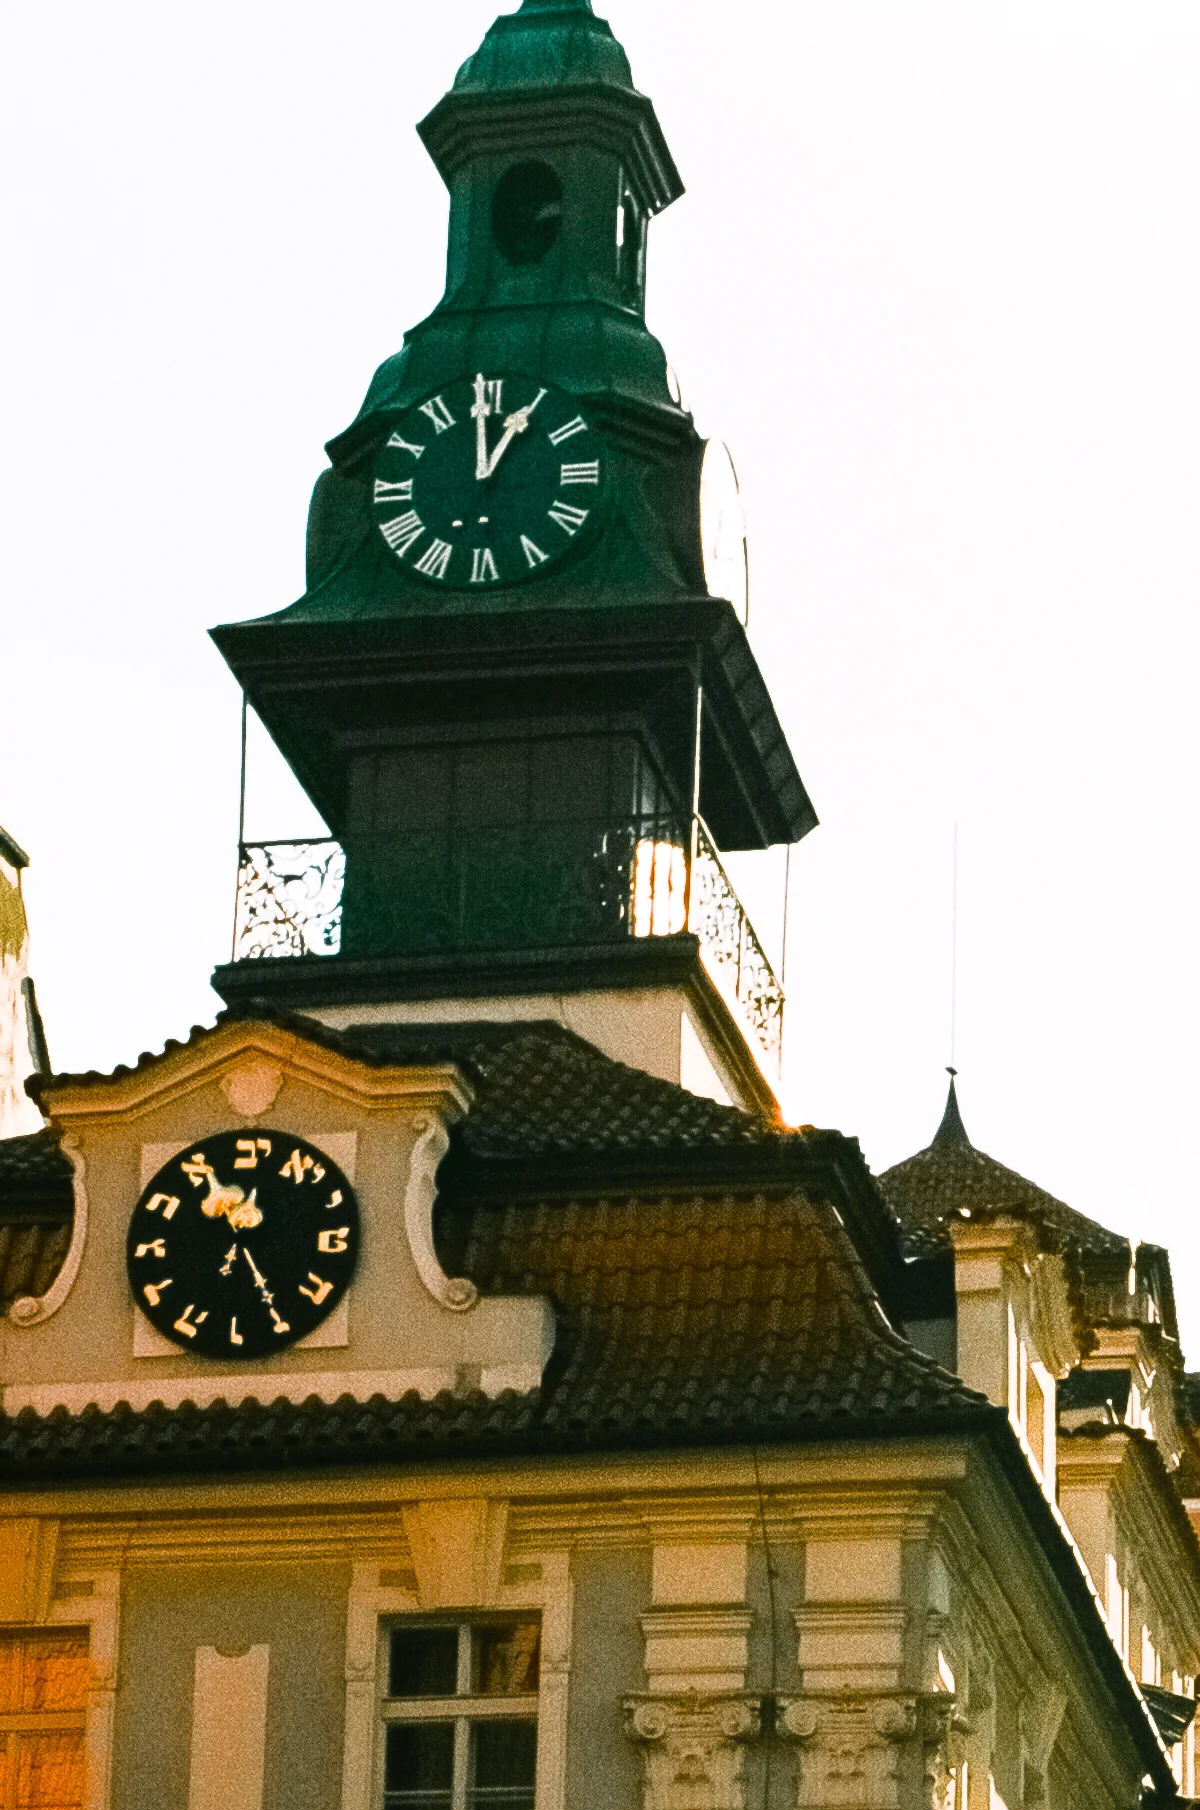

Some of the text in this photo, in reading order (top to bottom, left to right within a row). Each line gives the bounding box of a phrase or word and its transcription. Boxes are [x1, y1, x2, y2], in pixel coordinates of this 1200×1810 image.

[472, 379, 504, 414] II
[419, 396, 456, 433] XI
[548, 415, 588, 446] II
[387, 432, 425, 459] X
[560, 460, 599, 485] III
[374, 479, 413, 503] IX
[379, 509, 426, 558] VIII
[548, 500, 589, 536] IV
[413, 538, 452, 579] VII
[470, 548, 499, 582] VI
[520, 535, 549, 568] V
[234, 1138, 272, 1169] יב
[278, 1149, 326, 1185] יא
[181, 1153, 214, 1188] א
[325, 1189, 342, 1209] י
[318, 1227, 350, 1253] ט
